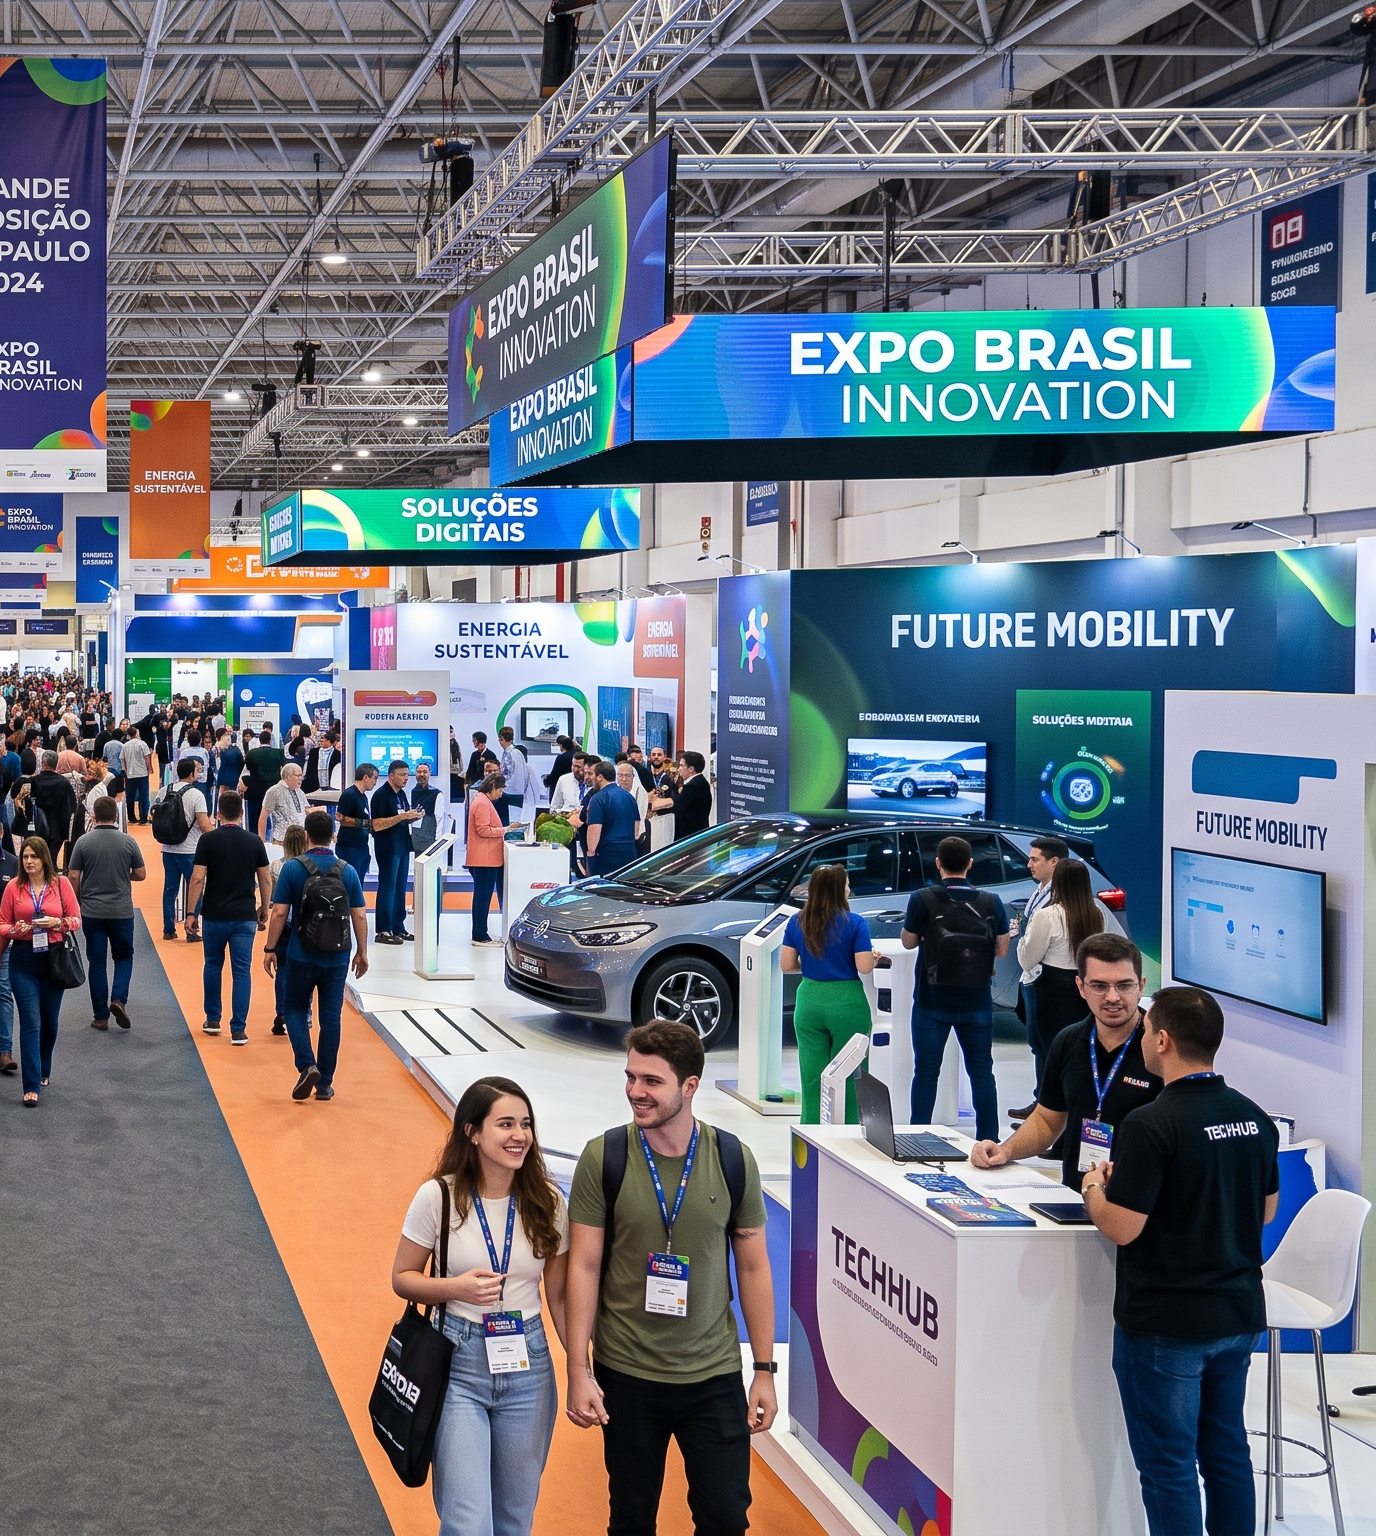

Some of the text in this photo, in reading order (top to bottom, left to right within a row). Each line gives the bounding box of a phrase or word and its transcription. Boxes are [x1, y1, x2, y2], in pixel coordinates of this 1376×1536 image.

[487, 223, 600, 340] EXPO BRASIL
[498, 284, 596, 381] INNOVATION
[790, 326, 1193, 376] EXPO BRASIL
[509, 363, 598, 433] EXPO BRASIL
[842, 380, 1177, 424] INNOVATION
[516, 405, 594, 467] INNOVATION
[134, 482, 207, 494] SUSTENTÁVEL
[144, 470, 196, 481] ENERGIA
[401, 492, 539, 524] SOLUÇÕES
[416, 522, 526, 542] DIGITAIS
[434, 640, 569, 659] SUSTENTÁVEL
[458, 622, 542, 638] ENERGIA
[892, 608, 1235, 649] FUTURE MOBILITY
[1196, 810, 1328, 852] FUTURE MOBILITY
[831, 1225, 939, 1341] TECHHUB
